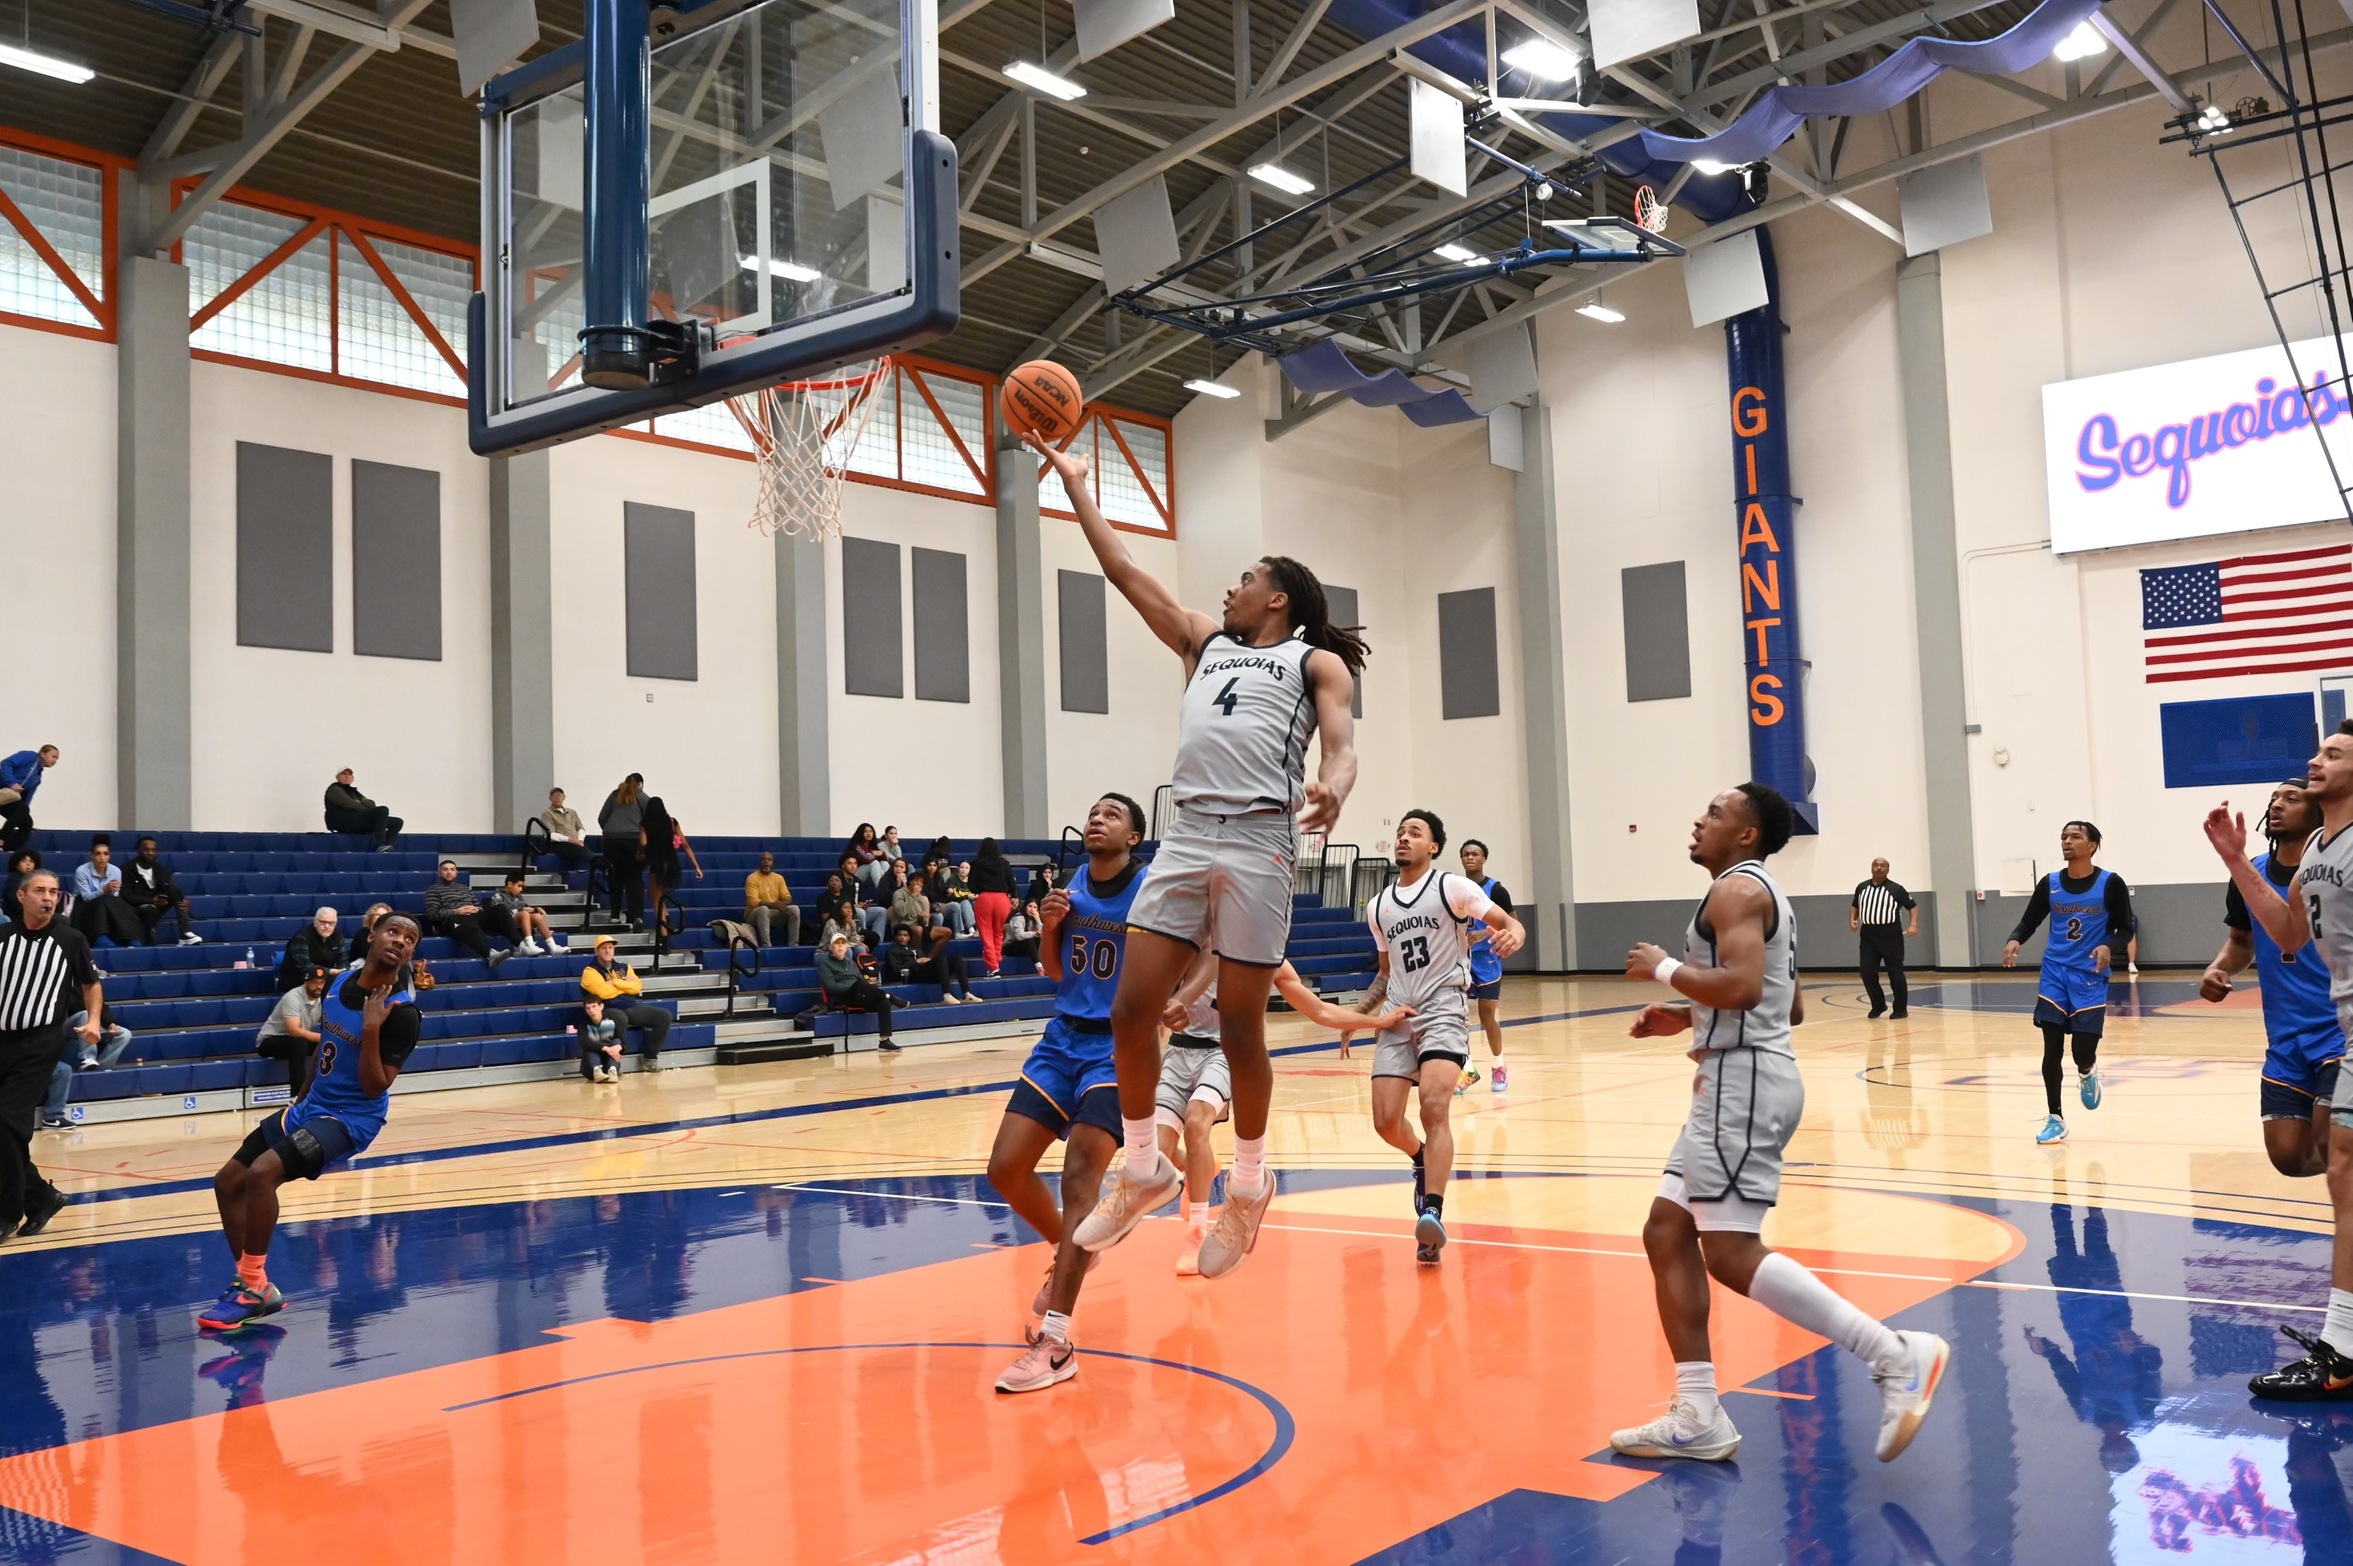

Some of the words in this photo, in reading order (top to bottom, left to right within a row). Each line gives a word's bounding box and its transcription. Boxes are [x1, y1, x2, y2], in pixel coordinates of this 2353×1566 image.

[1034, 375, 1069, 407] NCAA
[1014, 389, 1058, 432] Wilson
[2076, 370, 2343, 509] Sequoias
[1732, 386, 1785, 727] GIANTS
[1200, 657, 1286, 681] SEQUOIAS
[1212, 677, 1240, 716] 4
[2300, 864, 2343, 889] QUOIAS
[1387, 916, 1440, 943] SEQUOIAS
[2066, 917, 2083, 941] 2
[2310, 894, 2323, 939] 2
[1071, 934, 1117, 980] 50
[1400, 936, 1430, 973] 23
[319, 1041, 337, 1077] 3
